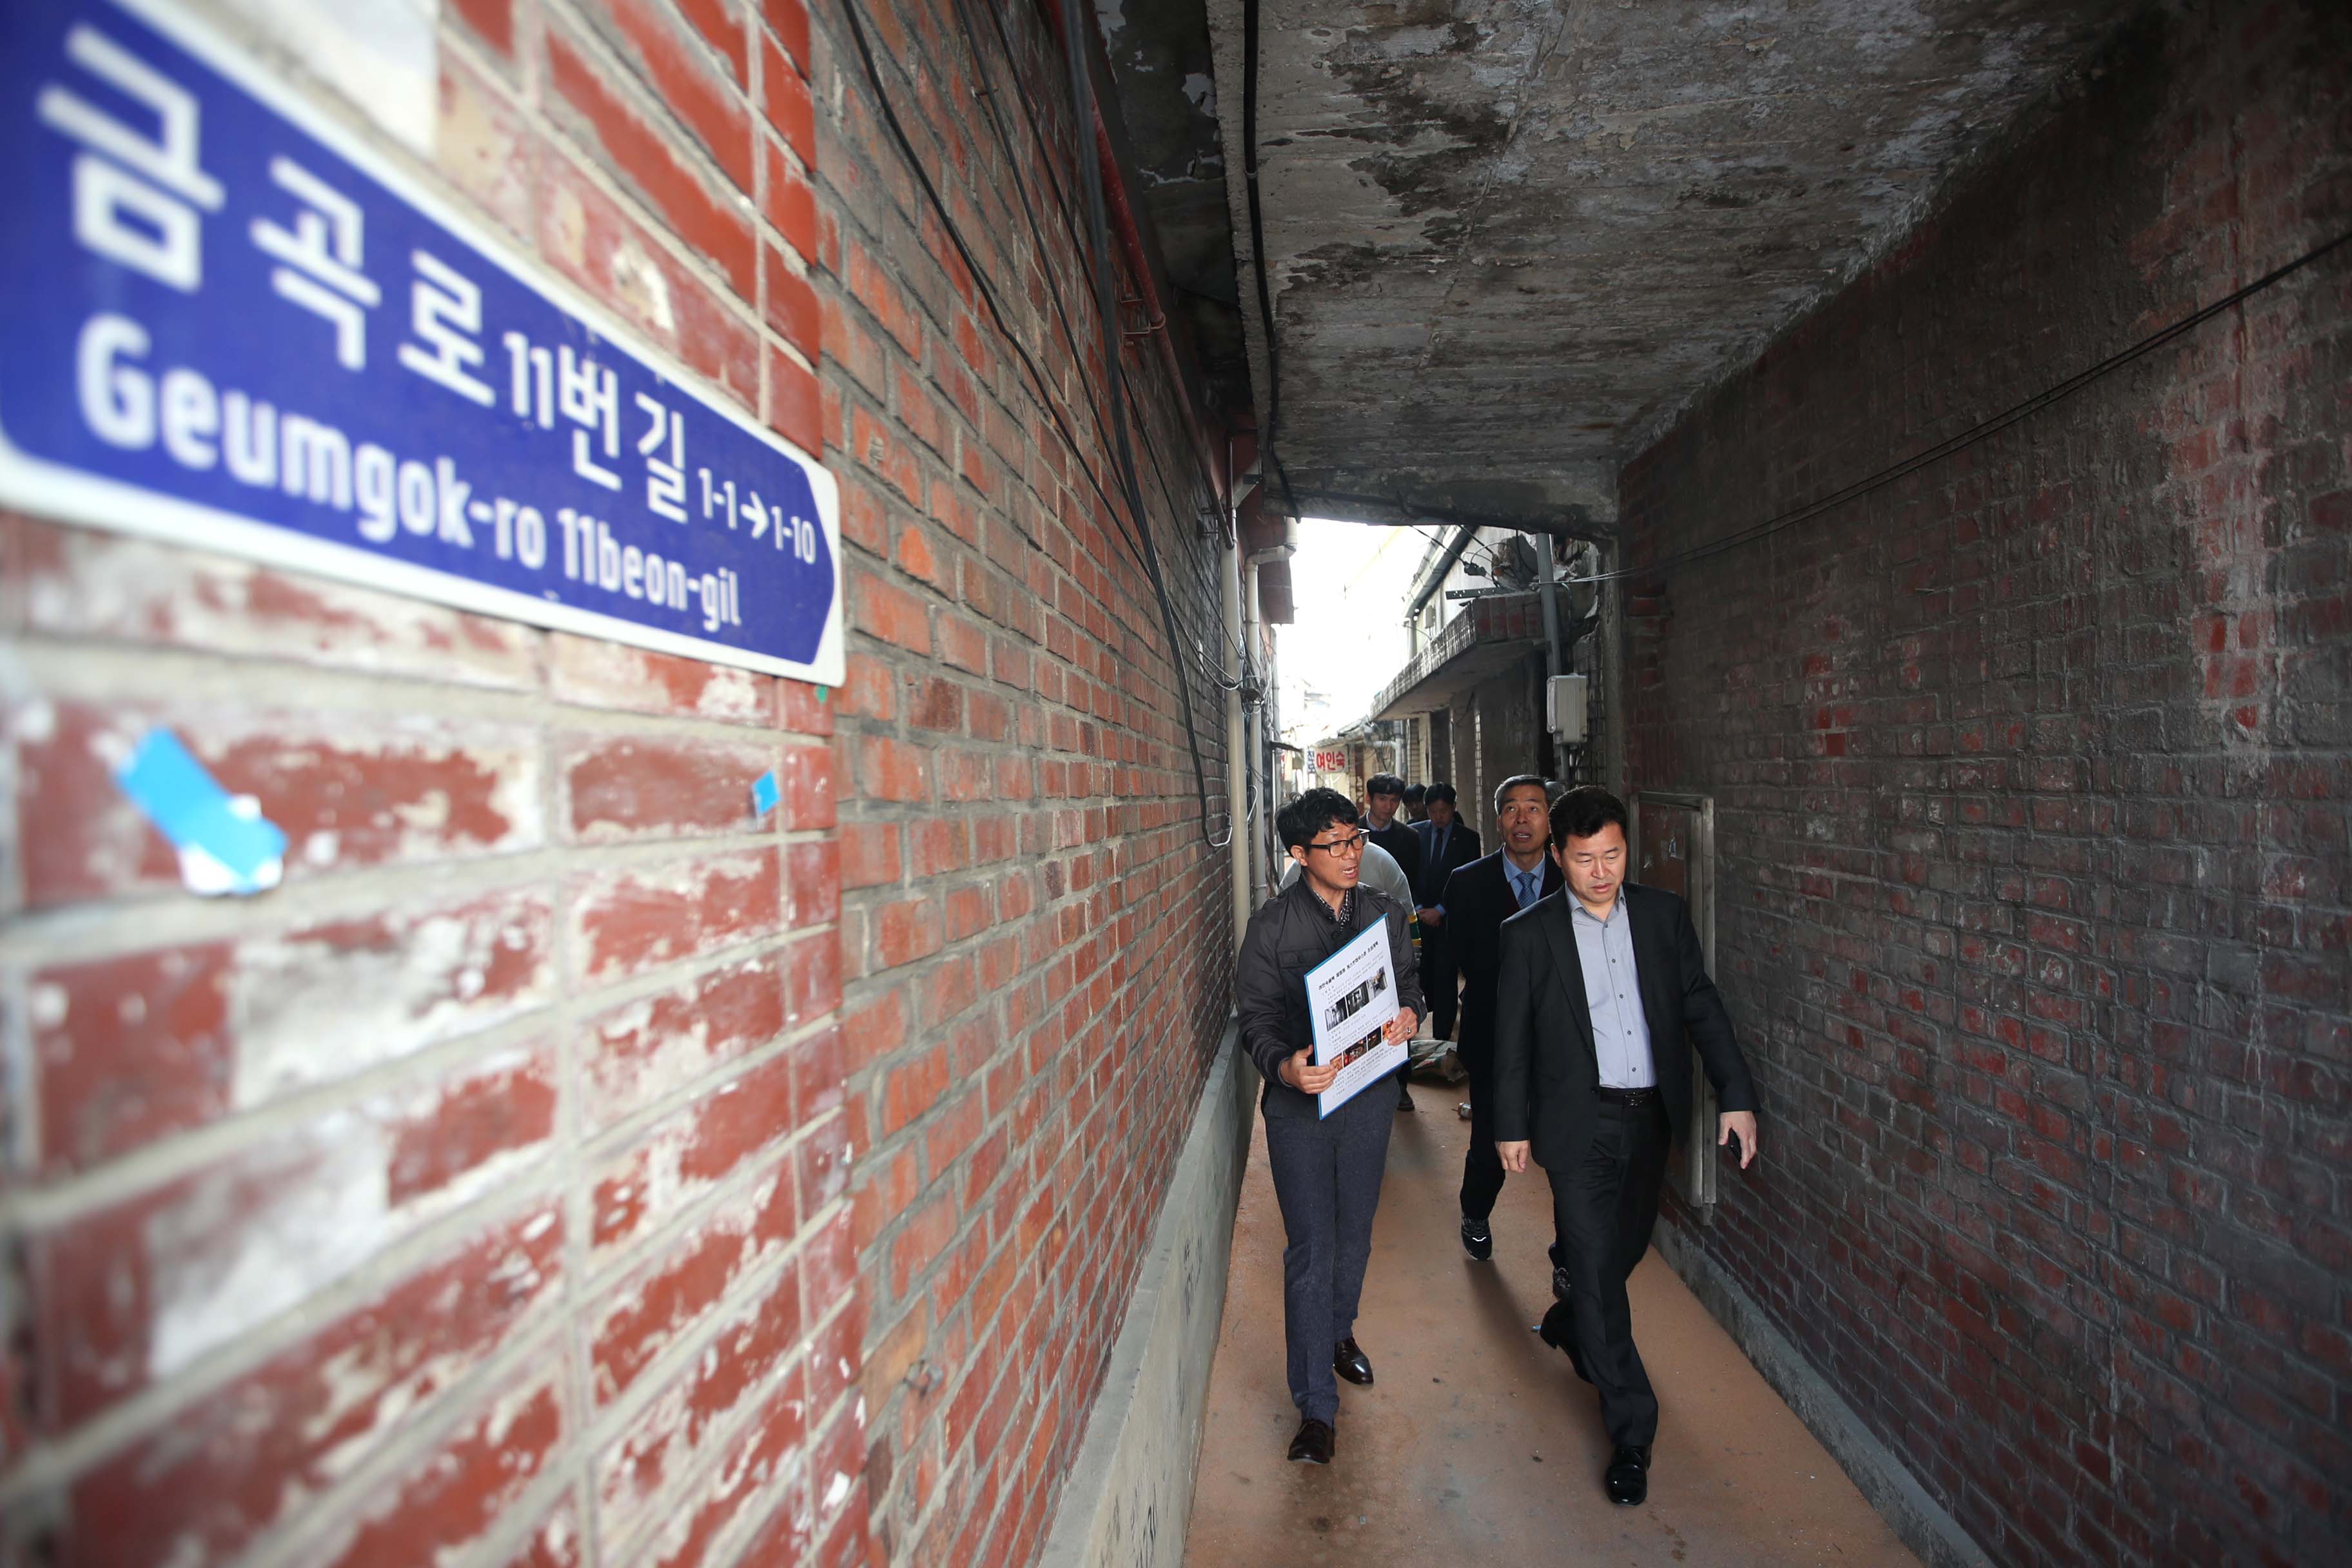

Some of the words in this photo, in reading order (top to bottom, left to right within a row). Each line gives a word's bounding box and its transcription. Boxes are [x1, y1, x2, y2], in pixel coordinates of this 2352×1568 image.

[79, 313, 547, 569] Geumgok-ro
[558, 508, 741, 632] 11beon-gil
[771, 506, 816, 564] 1-10
[1317, 750, 1345, 771] 여인숙
